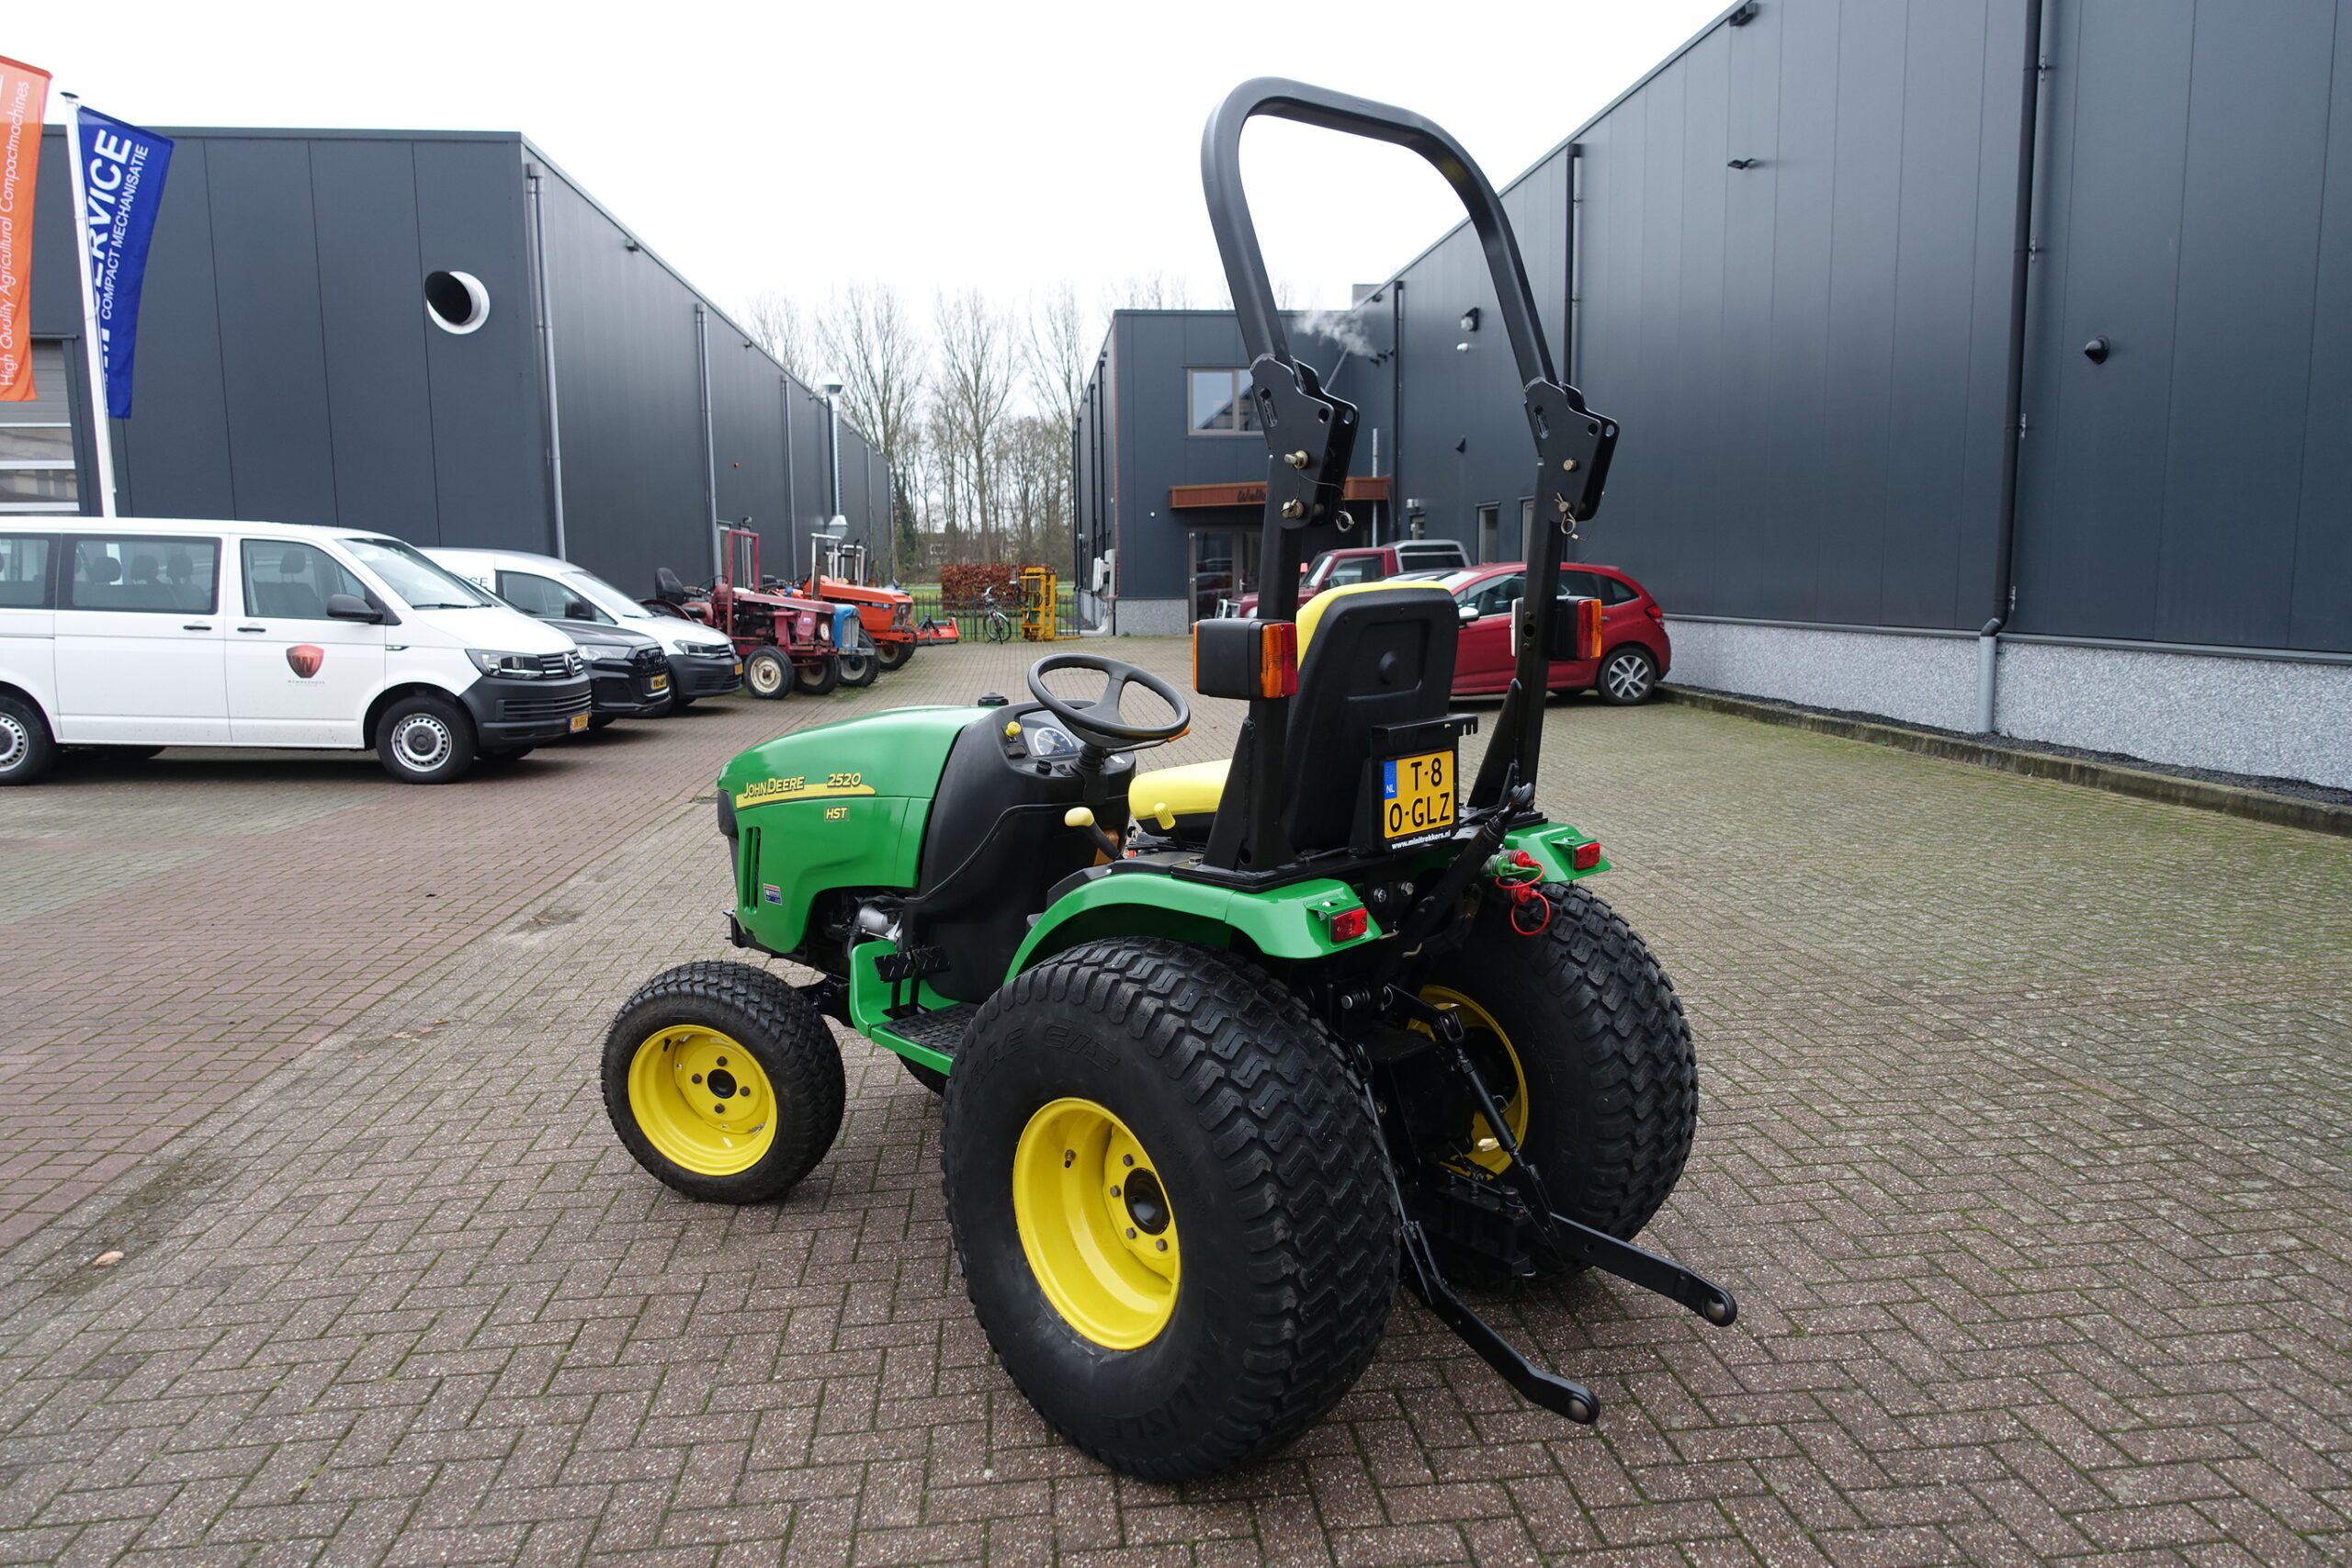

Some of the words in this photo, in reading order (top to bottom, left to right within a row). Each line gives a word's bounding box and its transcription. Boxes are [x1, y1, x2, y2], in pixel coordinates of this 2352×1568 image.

[0, 80, 29, 213] Compactmachines
[110, 143, 149, 249] MECHANISATIE
[0, 217, 17, 296] Agricultural
[101, 248, 121, 321] COMPACT
[0, 300, 17, 349] Quality
[0, 354, 18, 386] High
[827, 772, 862, 788] 2520
[1385, 784, 1396, 794] NL
[825, 807, 848, 820] HST
